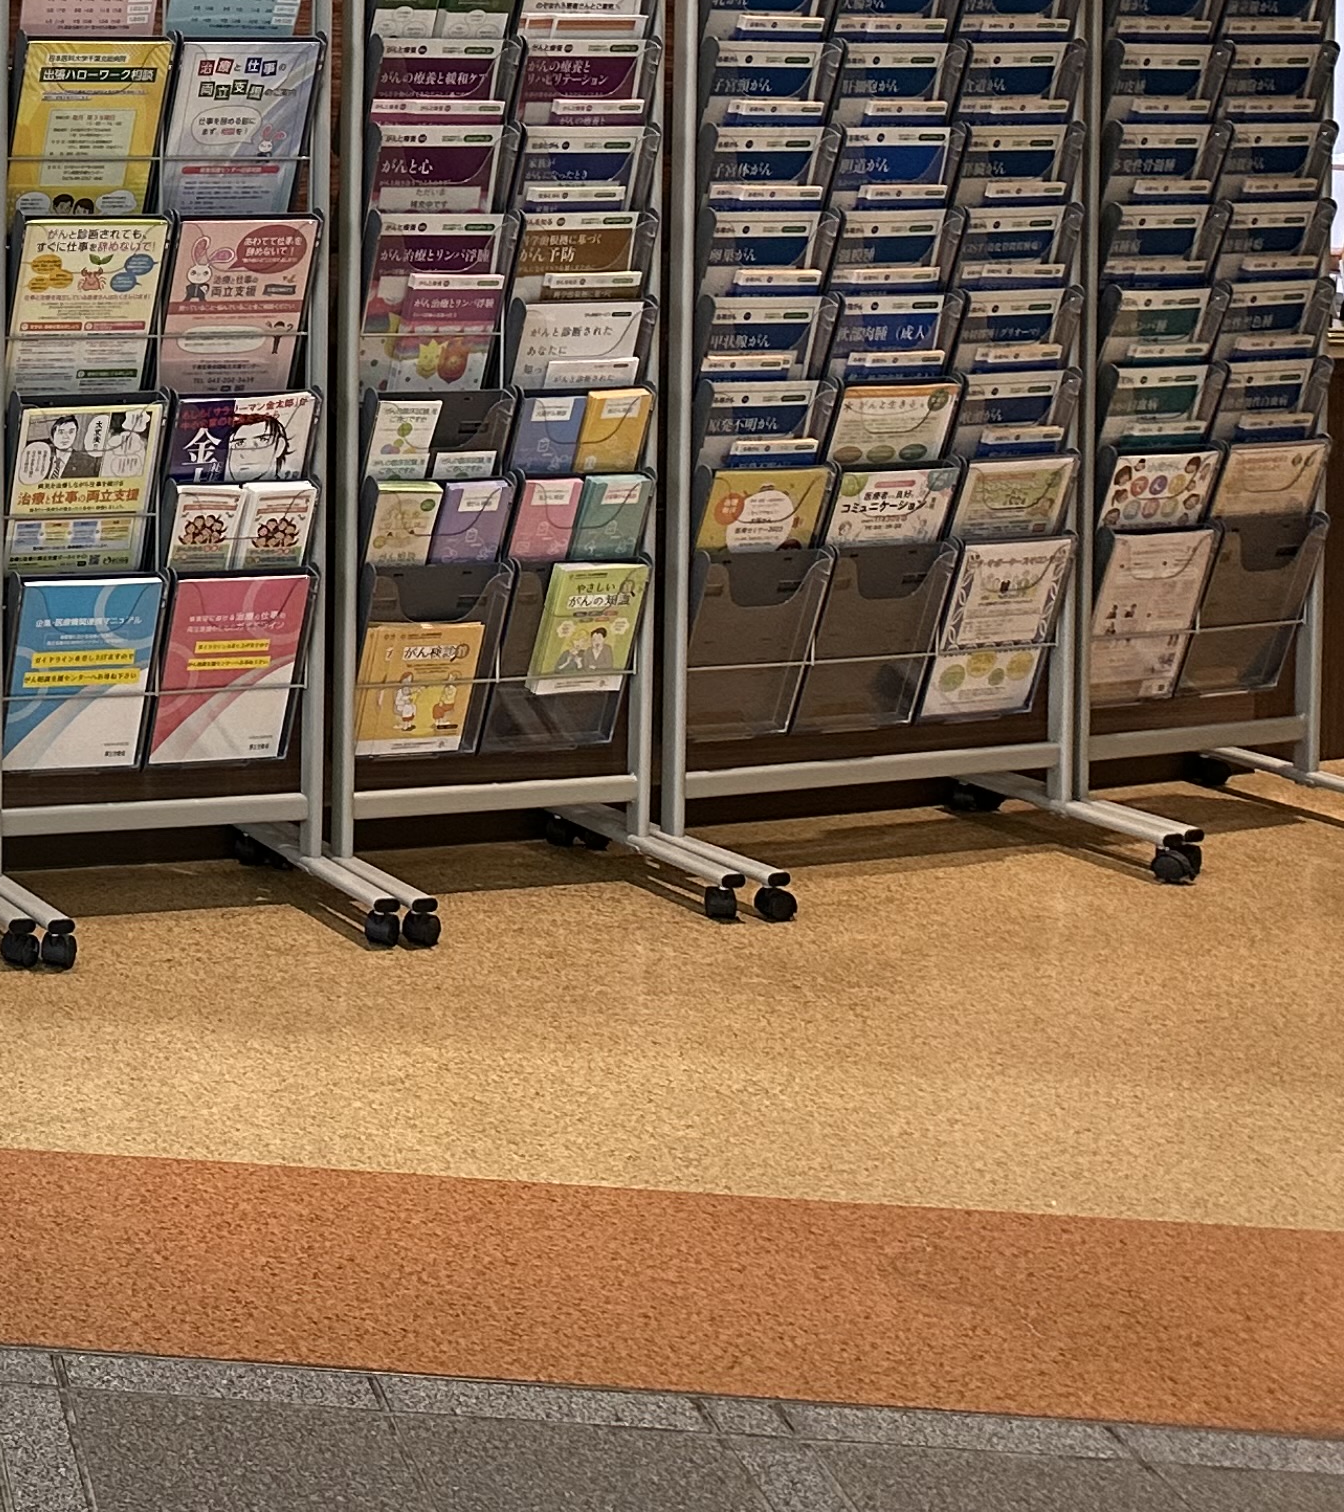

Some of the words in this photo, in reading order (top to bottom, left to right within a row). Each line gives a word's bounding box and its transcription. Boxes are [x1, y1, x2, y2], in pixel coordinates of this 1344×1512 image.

[42, 68, 155, 82] 出張ハローワーク相談
[381, 159, 434, 175] がんと心
[17, 488, 140, 506] 治療と仕事の両立支援
[841, 498, 927, 515] コミュニケーション
